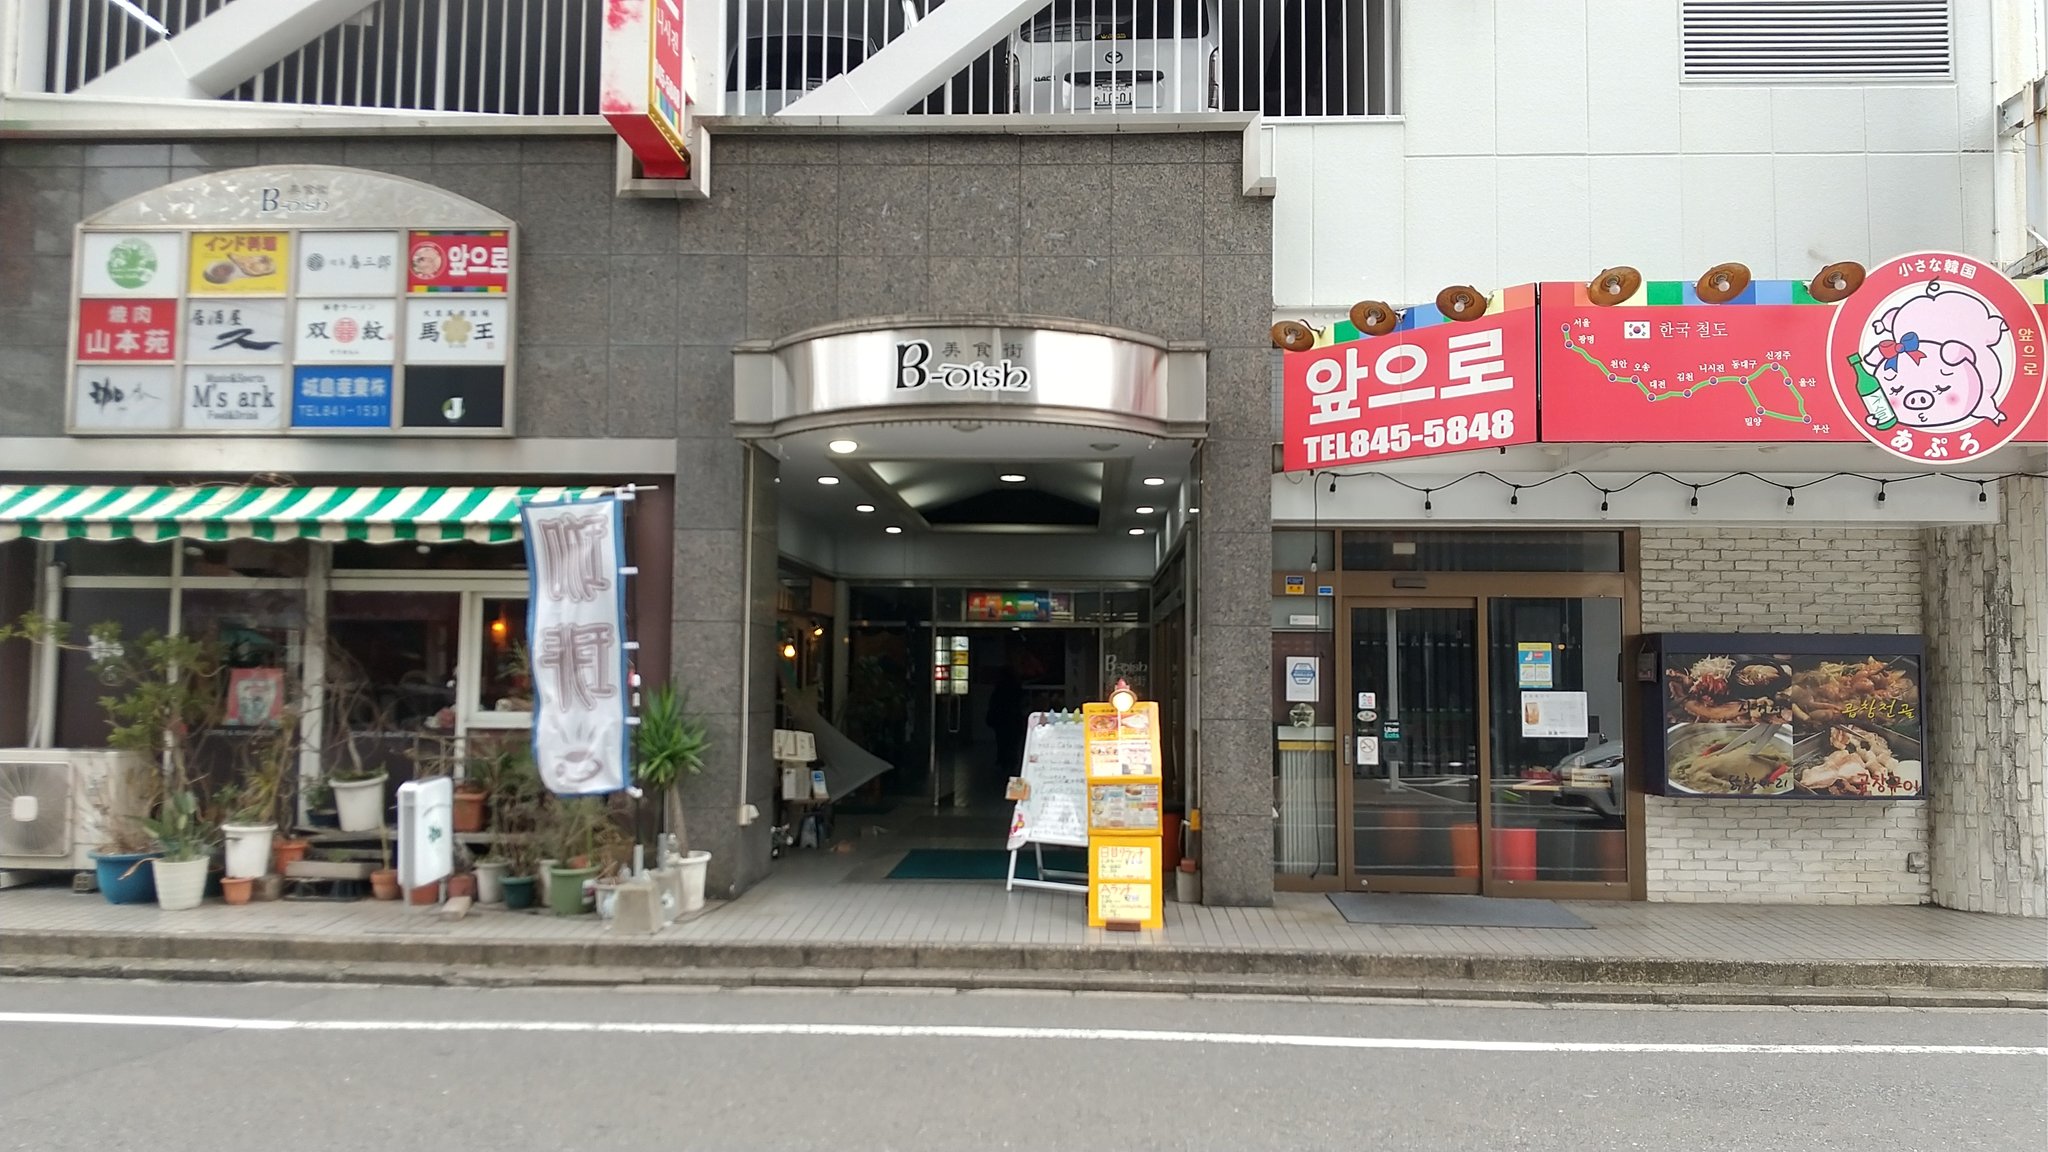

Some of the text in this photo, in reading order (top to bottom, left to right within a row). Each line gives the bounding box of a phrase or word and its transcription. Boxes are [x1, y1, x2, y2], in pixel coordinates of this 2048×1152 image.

[448, 243, 509, 277] 앞으로
[1898, 257, 1977, 280] 小さな韓国
[1573, 318, 1591, 328] 서울
[1660, 321, 1729, 339] 한국 철도
[84, 328, 171, 354] 山本苑
[1577, 334, 1595, 345] 광명
[941, 340, 1024, 360] 美食街
[1765, 350, 1792, 360] 신경주
[2017, 327, 2039, 376] 앞으로
[1609, 359, 1628, 369] 천안
[1632, 362, 1651, 373] 오송
[1731, 359, 1758, 370] 동대구
[1305, 328, 1514, 426] 앞으로
[1649, 379, 1667, 390] 대전
[1676, 371, 1695, 383] 김천
[1798, 377, 1817, 388] 울산
[191, 384, 229, 409] M's
[238, 384, 276, 409] ark
[1744, 416, 1763, 428] 밀양
[1812, 424, 1831, 435] 부산
[1302, 408, 1515, 464] TEL845-5848
[1890, 429, 1980, 458] あぷろ
[1841, 699, 1916, 721] 곱창전골
